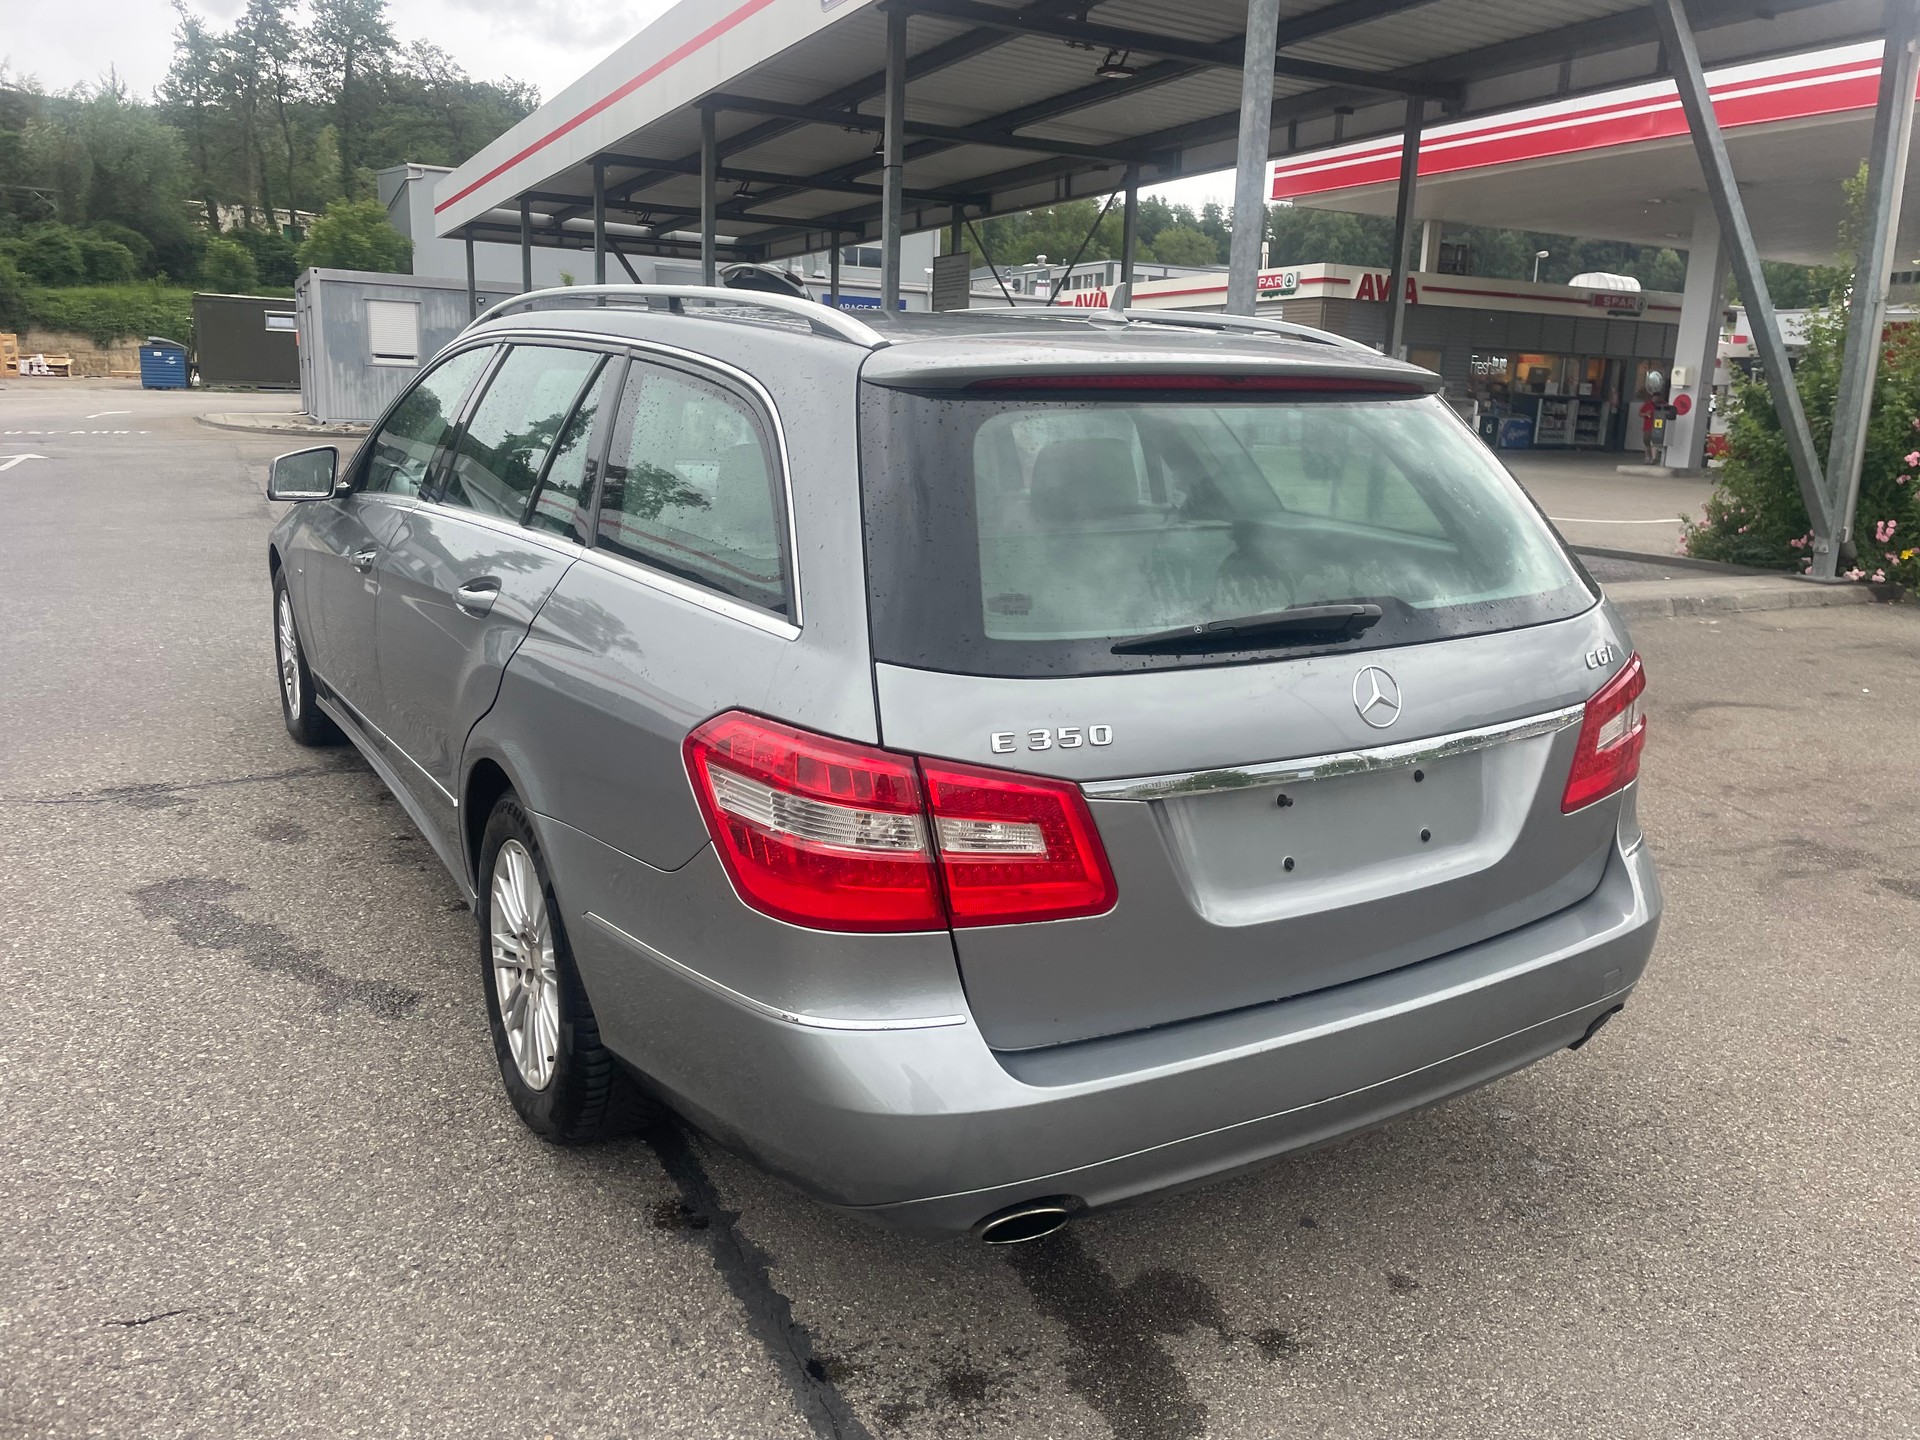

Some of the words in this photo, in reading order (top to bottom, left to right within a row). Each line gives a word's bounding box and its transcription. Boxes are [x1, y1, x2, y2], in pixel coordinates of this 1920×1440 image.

[1258, 276, 1282, 288] PAR
[1356, 274, 1418, 304] AVA
[1075, 290, 1108, 307] AVIA
[1603, 297, 1635, 307] SPAR
[1470, 355, 1492, 375] Fresh
[1492, 356, 1499, 367] to
[1585, 645, 1614, 670] CGI
[990, 731, 1017, 754] E
[1028, 725, 1113, 751] 350
